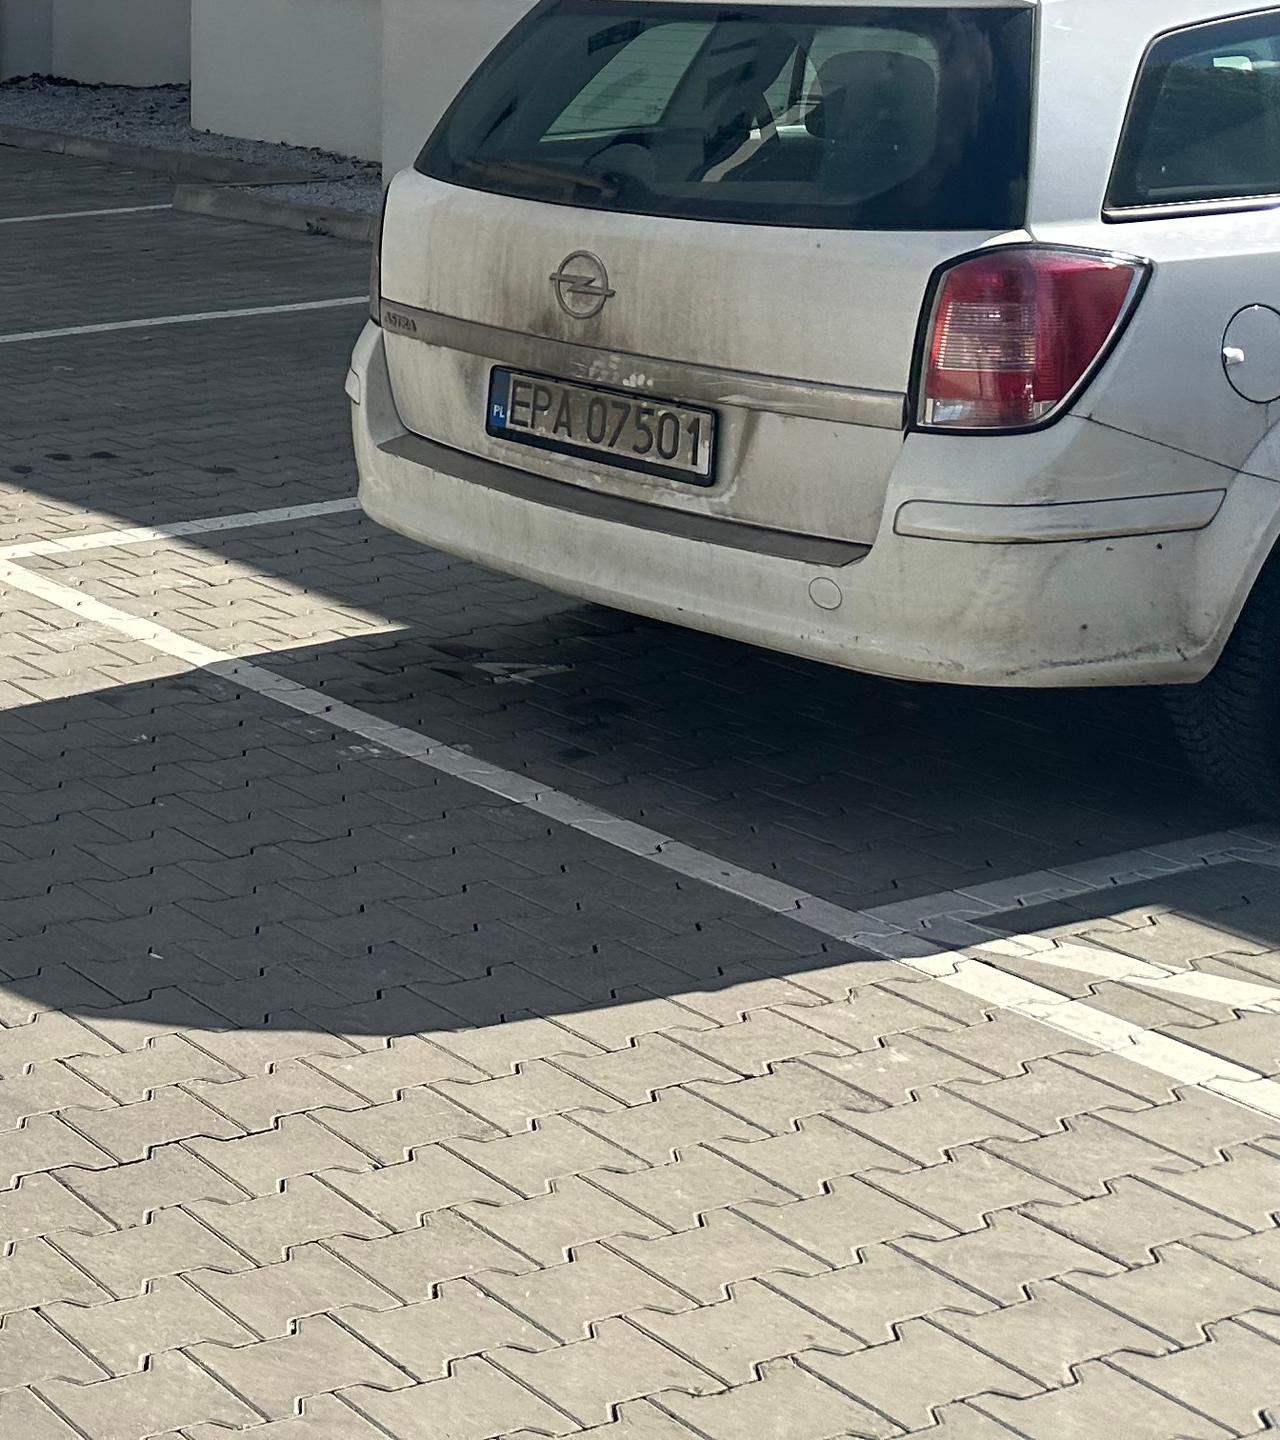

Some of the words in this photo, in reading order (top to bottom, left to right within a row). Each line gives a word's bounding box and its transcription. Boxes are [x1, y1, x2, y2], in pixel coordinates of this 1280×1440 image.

[493, 404, 505, 419] PL
[510, 379, 572, 438] EPA
[587, 396, 700, 466] 07501
